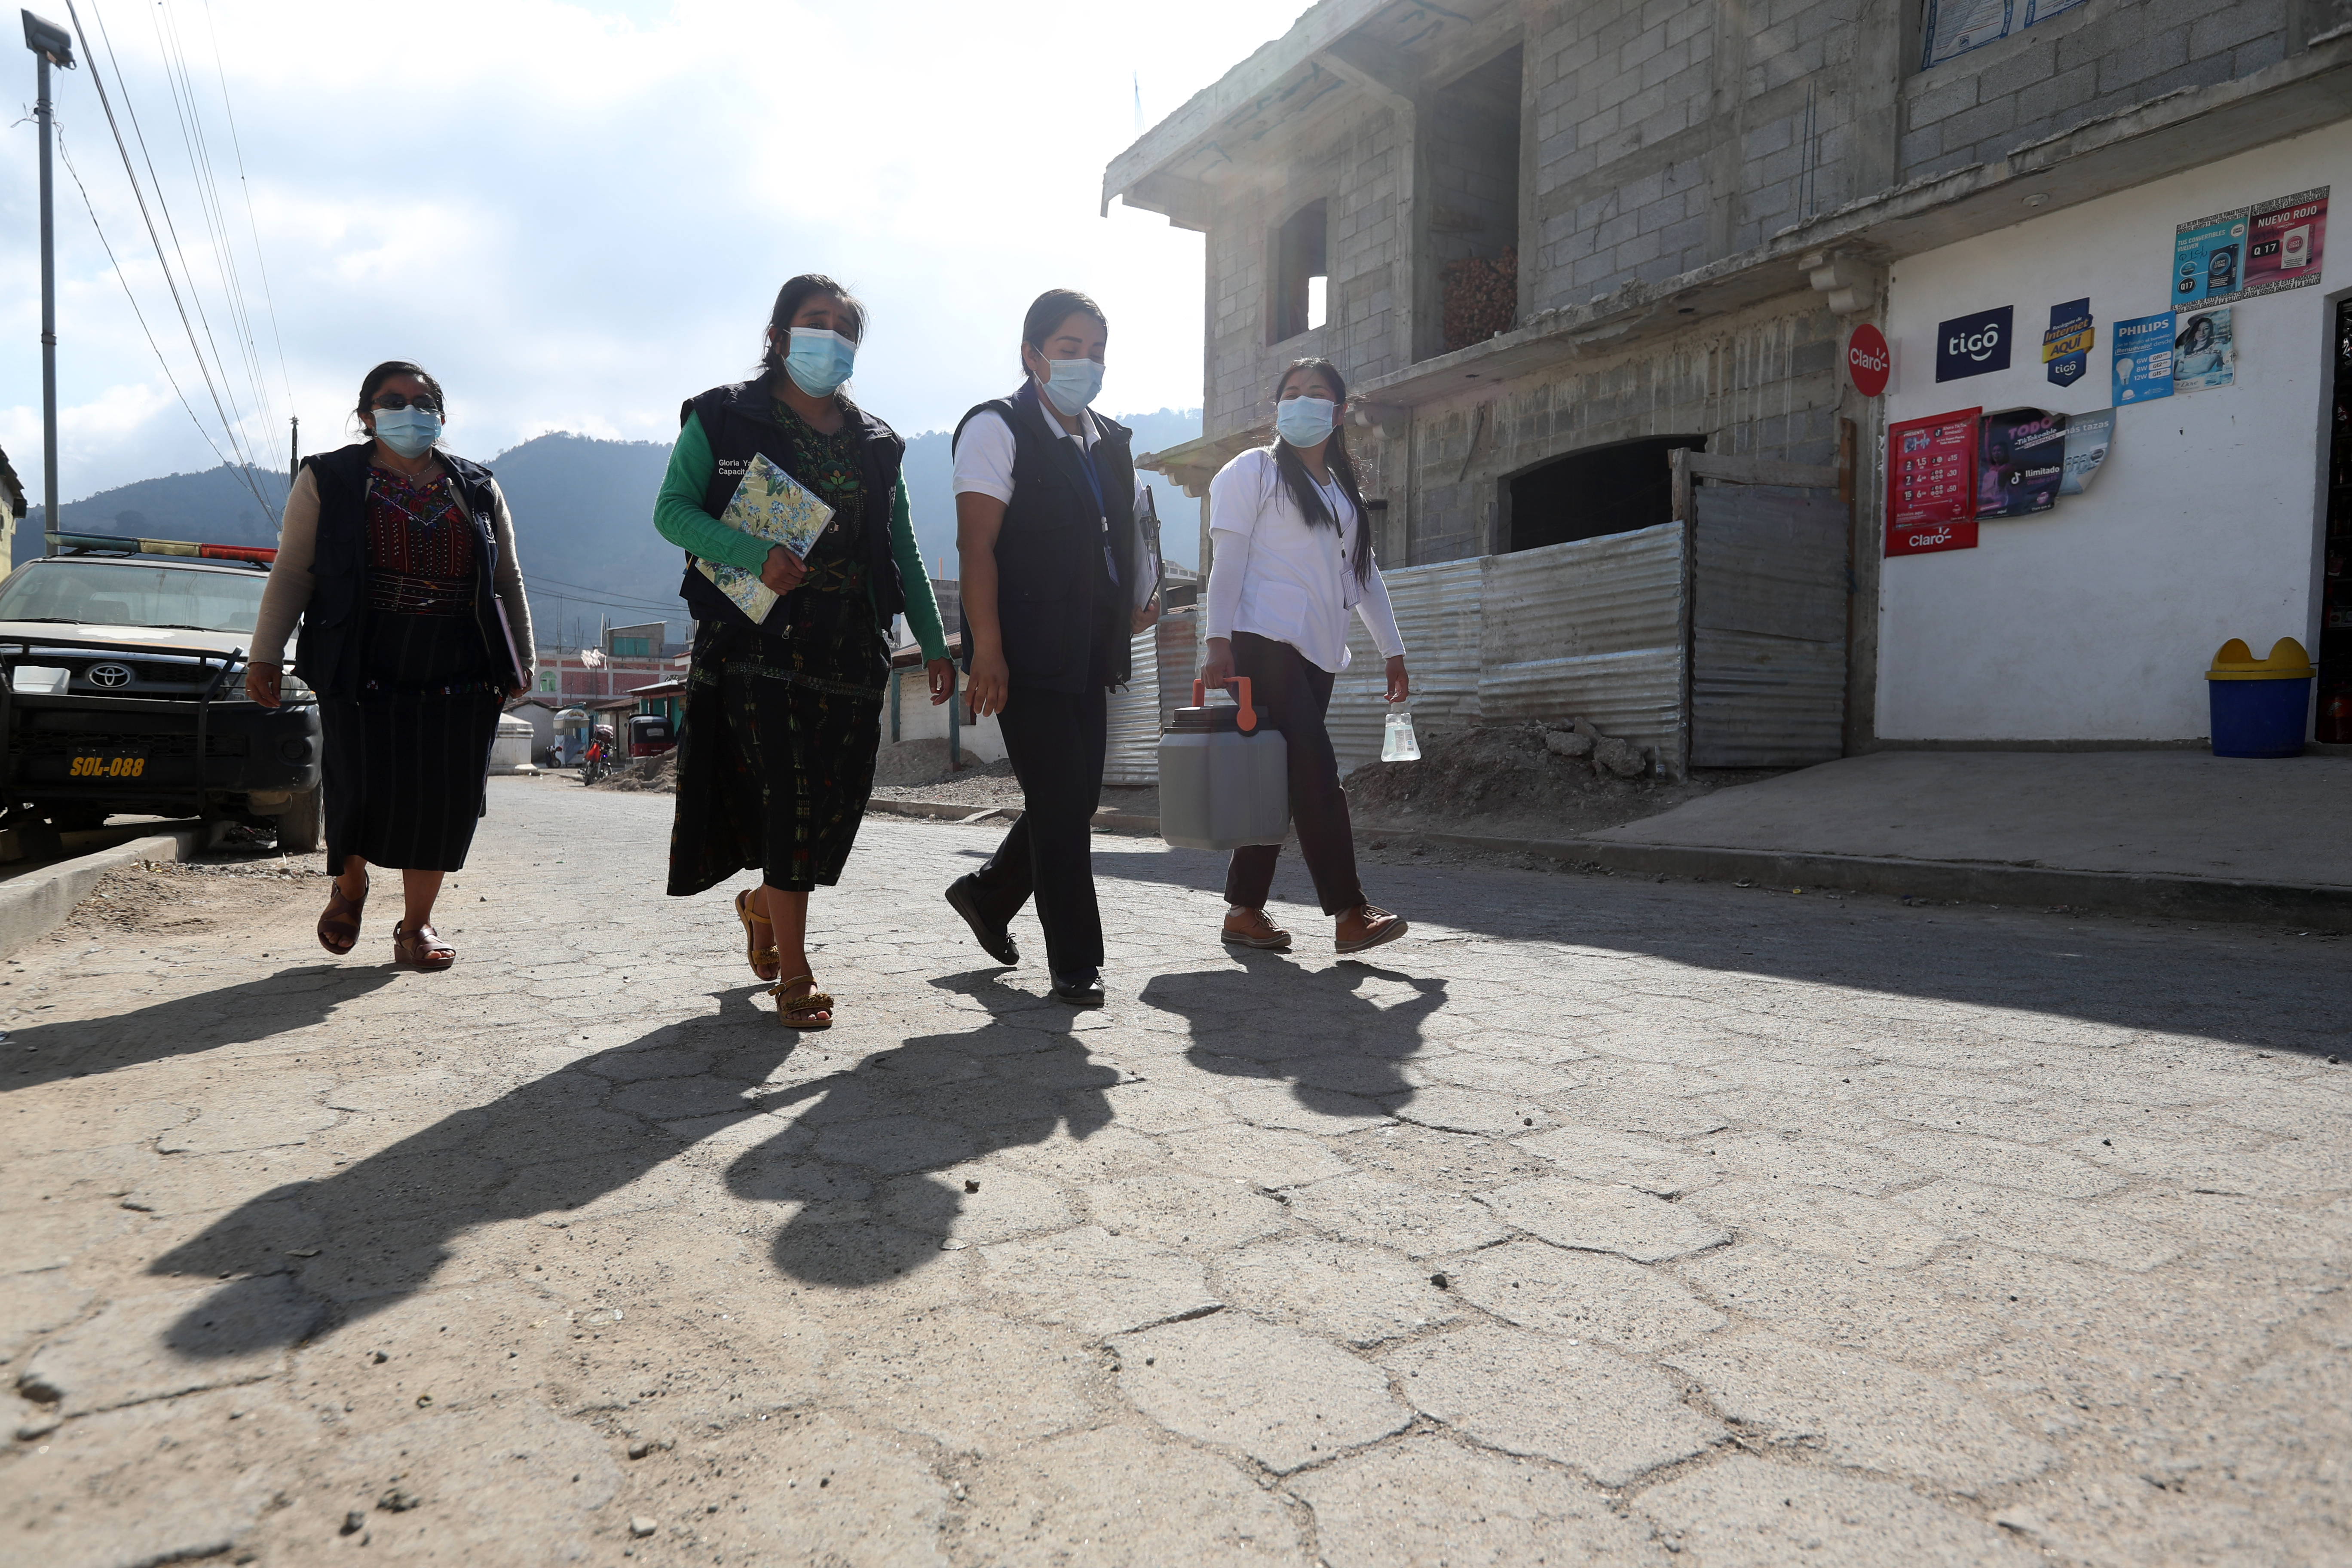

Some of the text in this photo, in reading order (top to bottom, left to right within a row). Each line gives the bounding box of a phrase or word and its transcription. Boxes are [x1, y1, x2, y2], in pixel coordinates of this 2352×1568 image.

[2251, 191, 2328, 215] ENFERMEDADES CARDIOVASCULARES
[2257, 199, 2274, 208] CONSUMO
[2291, 191, 2310, 200] PRODUCTO
[2258, 205, 2317, 228] NUEVO ROJO
[2188, 230, 2226, 243] CONVERTIBLES
[2177, 242, 2199, 252] VUELVEN
[2254, 243, 2276, 255] Q 17
[2180, 282, 2193, 290] Q17
[2250, 283, 2272, 292] CONSUMO
[2294, 272, 2320, 282] PRODUCTO
[2304, 277, 2320, 285] SALUD
[2177, 300, 2199, 308] CONSUMO
[2218, 291, 2242, 300] PRODUCTO
[2046, 318, 2089, 341] Internet
[2119, 319, 2169, 337] PHILIPS
[1949, 325, 1998, 359] tigo
[2050, 334, 2082, 356] AQUÍ
[2153, 338, 2172, 346] desde
[1850, 348, 1884, 371] Claro
[2055, 362, 2076, 375] tigo
[2008, 416, 2052, 440] TODO
[2083, 421, 2109, 431] tazas
[2024, 434, 2057, 448] SUPERPACKS
[1917, 458, 1926, 466] 1.5
[719, 468, 746, 476] Capacit
[2026, 466, 2060, 478] Ilimitado
[1909, 530, 1948, 547] Claro
[70, 757, 145, 777] SOL-088
